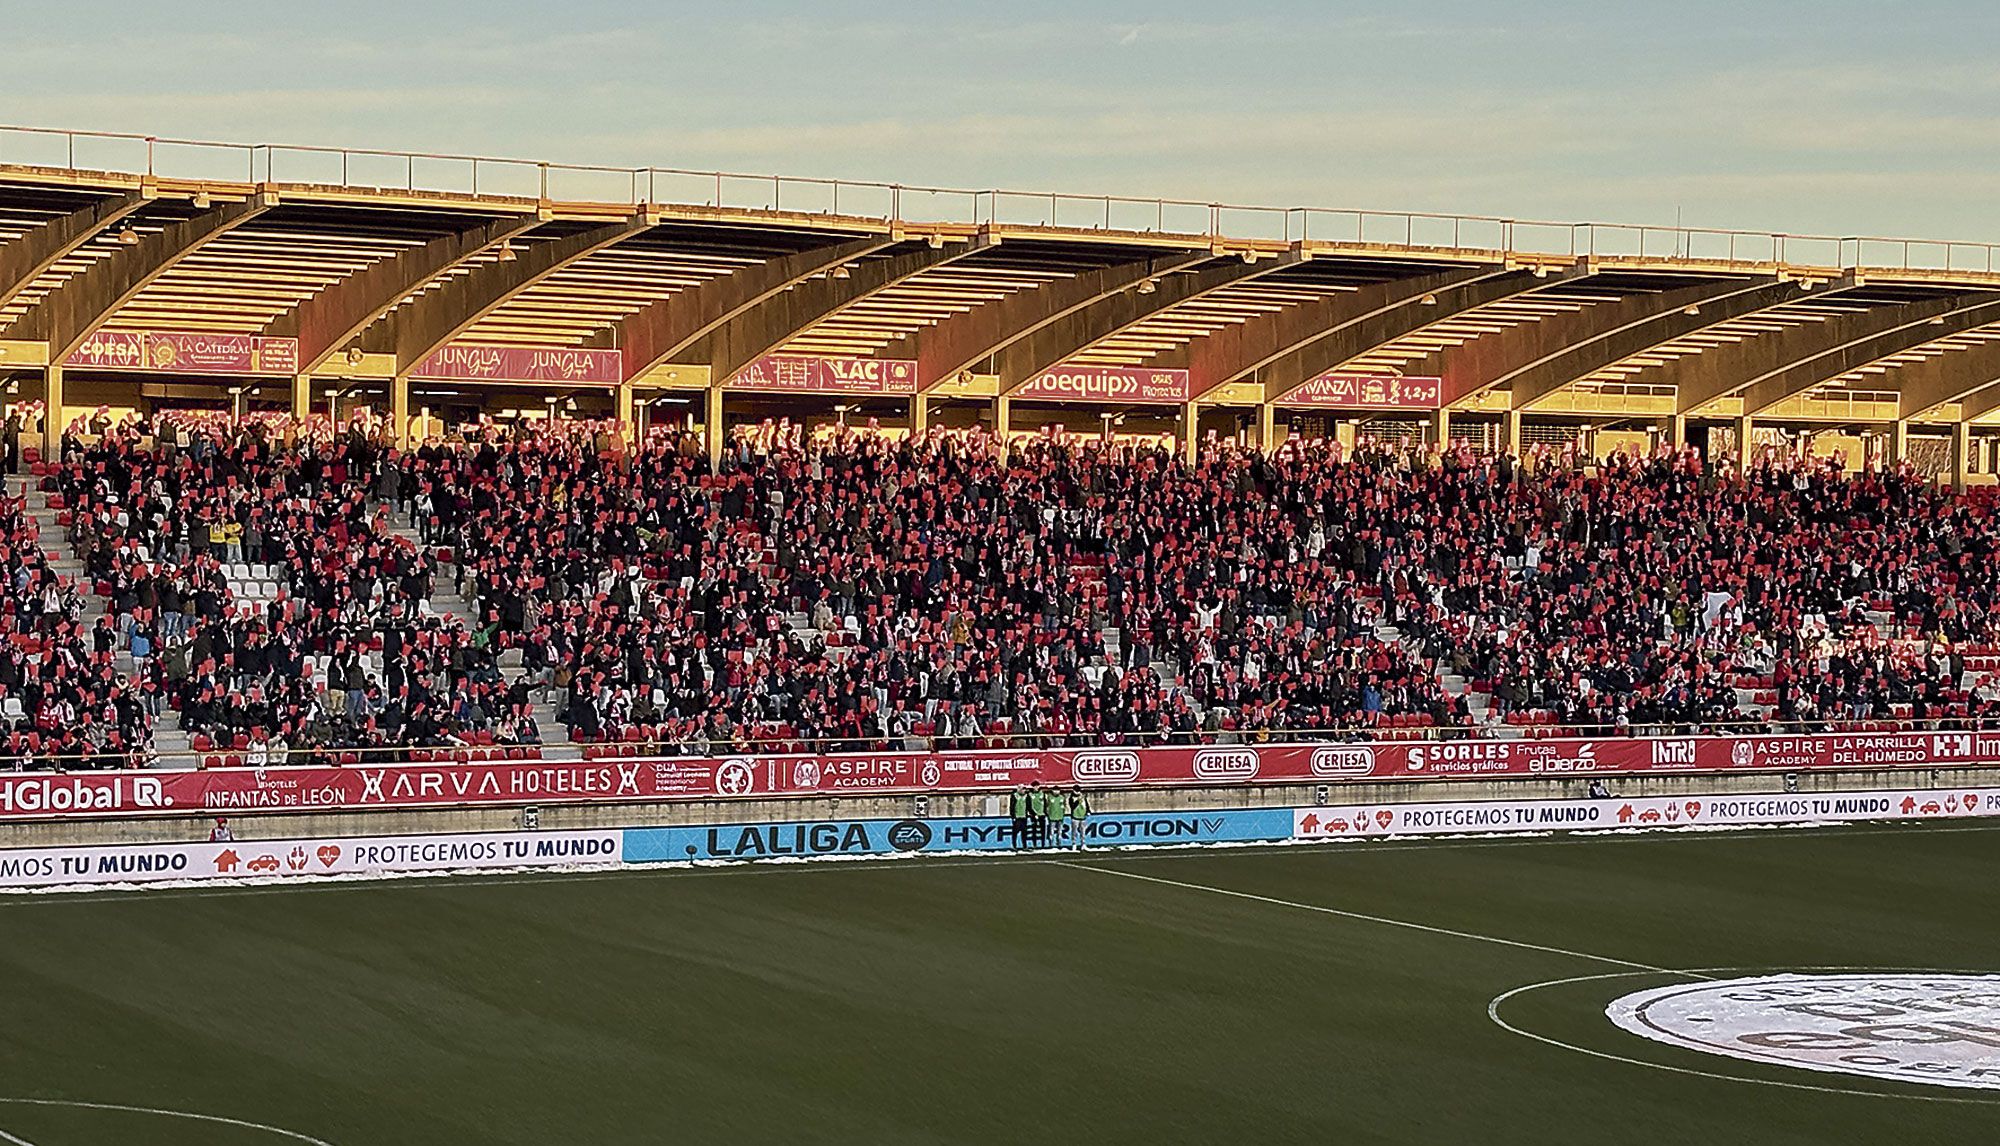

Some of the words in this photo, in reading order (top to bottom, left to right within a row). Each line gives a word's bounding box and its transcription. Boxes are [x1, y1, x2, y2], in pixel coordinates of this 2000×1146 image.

[195, 342, 250, 354] CATEDRAL
[435, 348, 501, 376] JUNGLA
[530, 351, 594, 379] JUNGLA
[1429, 744, 1511, 761] SORLES
[1516, 744, 1558, 756] Frutas
[1756, 738, 1826, 755] ASPIRE
[1833, 738, 1853, 750] LA
[1855, 737, 1927, 749] PARRILLA
[1430, 762, 1472, 772] servicios
[1473, 760, 1510, 773] gráficos
[1765, 756, 1818, 765] ACADEMY
[1832, 752, 1862, 763] DEL
[823, 758, 908, 776] ASPIRE
[391, 770, 501, 797] ARVA
[511, 768, 611, 794] HOTELES
[834, 776, 897, 787] ACADEMY
[205, 789, 281, 808] INFANTAS
[284, 794, 298, 805] DE
[302, 785, 345, 804] LEÓN
[1403, 809, 1511, 827] PROTEGEMOS
[1515, 808, 1535, 823] TU
[1539, 806, 1600, 822] MUNDO
[1710, 801, 1809, 818] PROTEGEMOS
[1811, 801, 1830, 814] TU
[1834, 798, 1891, 814] MUNDO
[707, 823, 871, 856] LALIGA
[354, 842, 497, 864] PROTEGEMOS
[502, 841, 529, 858] TU
[535, 838, 616, 857] MUNDO
[61, 857, 90, 875] TU
[97, 853, 188, 873] MUNDO
